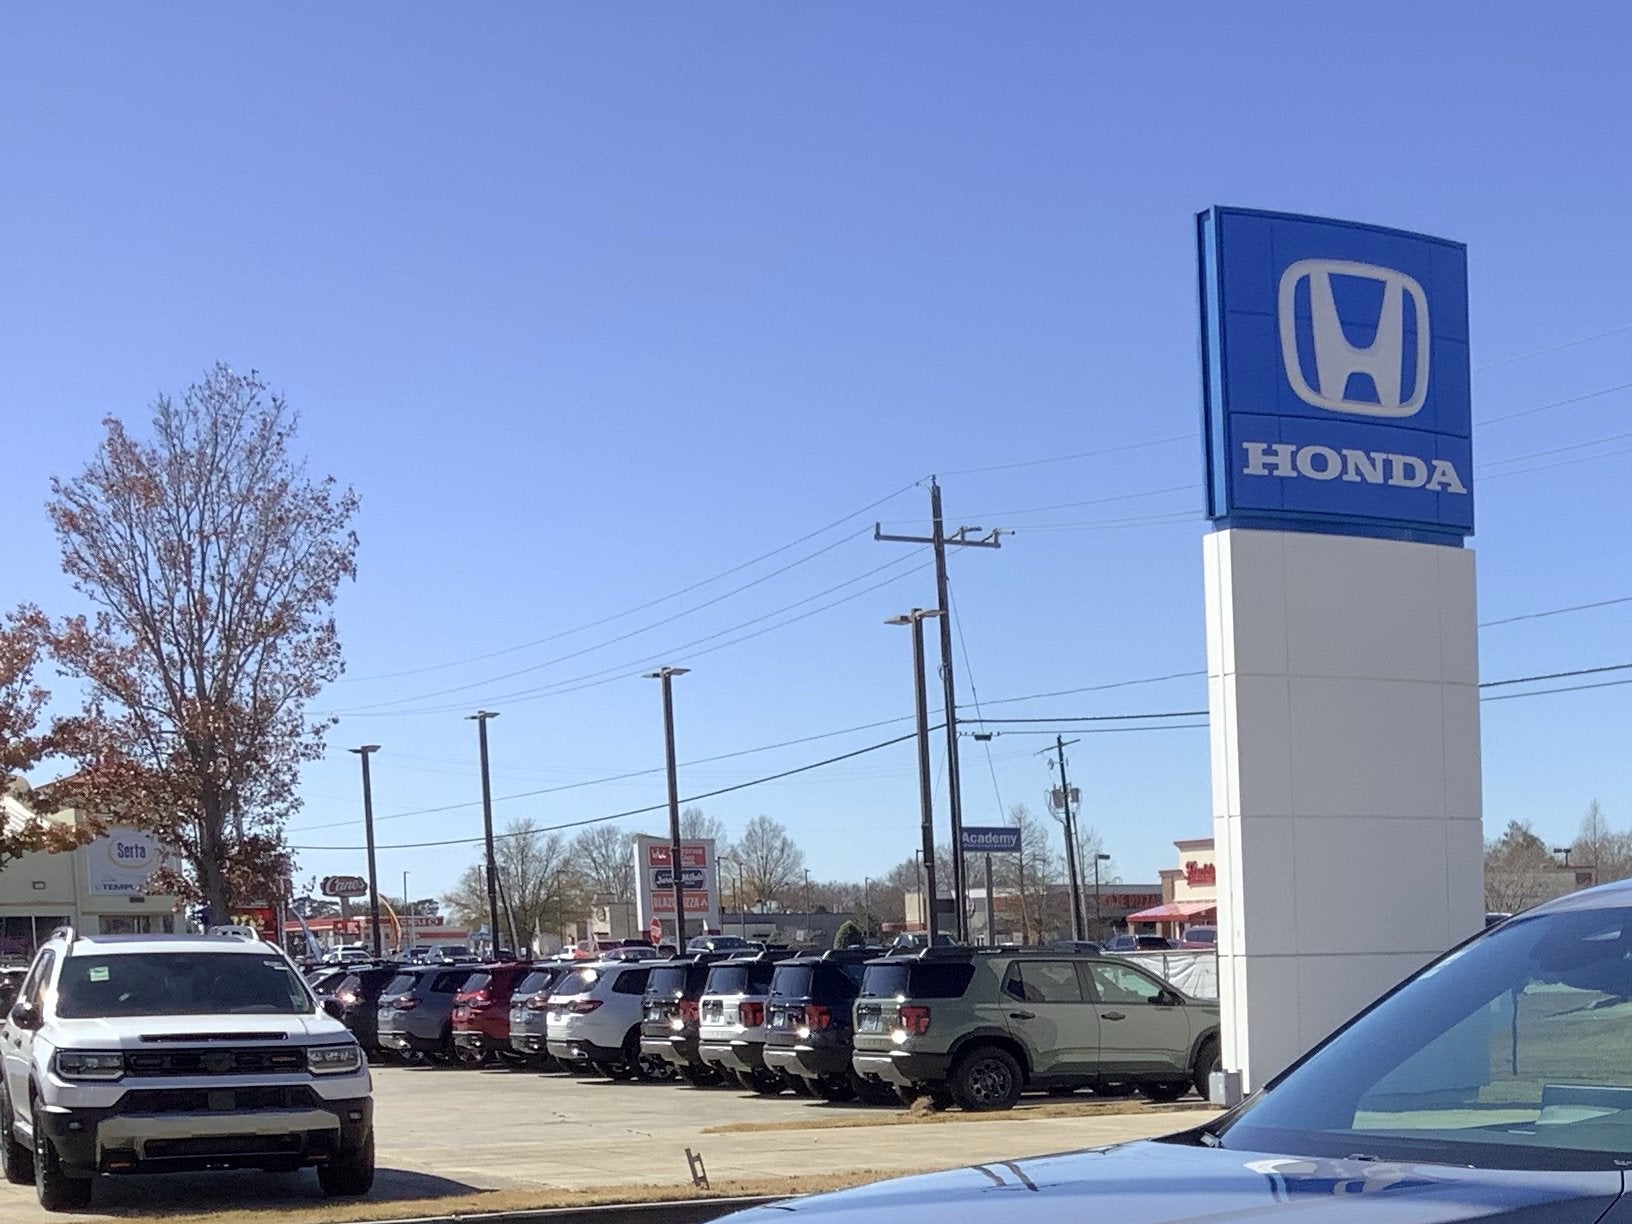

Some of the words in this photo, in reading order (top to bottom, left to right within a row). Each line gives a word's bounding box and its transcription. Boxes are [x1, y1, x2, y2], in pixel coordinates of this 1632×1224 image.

[1242, 442, 1467, 494] HONDA
[962, 831, 1018, 847] Academy
[117, 842, 147, 859] Serta
